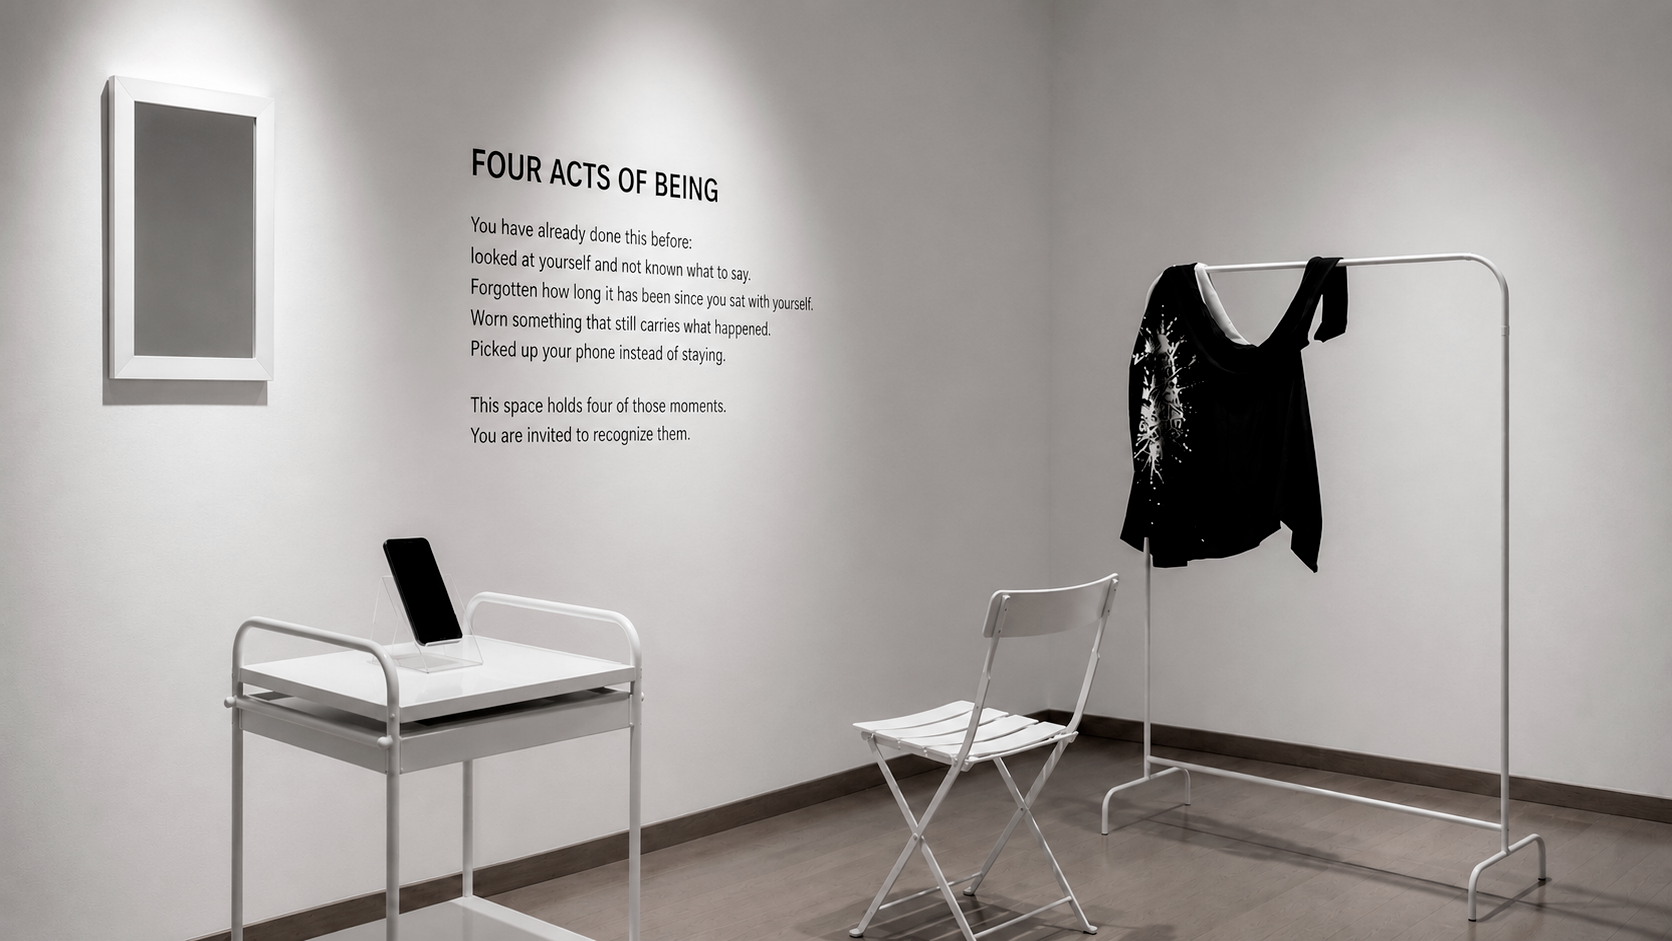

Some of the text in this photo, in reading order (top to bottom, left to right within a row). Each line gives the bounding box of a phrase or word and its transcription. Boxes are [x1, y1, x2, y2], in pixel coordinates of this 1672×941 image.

[473, 148, 718, 202] FOUR ACTS OF BEING
[471, 216, 692, 249] You have already done this before:
[471, 246, 751, 284] looked at yourself and not known what to say.
[471, 278, 813, 312] Forgotten how long it has been since you sat with yourself.
[471, 309, 770, 339] Worn something that still carries what happened.
[471, 340, 725, 365] Picked up your phone instead of staying.
[470, 396, 726, 417] This space holds four of those moments.
[471, 426, 690, 445] You are invited to recognize them.
